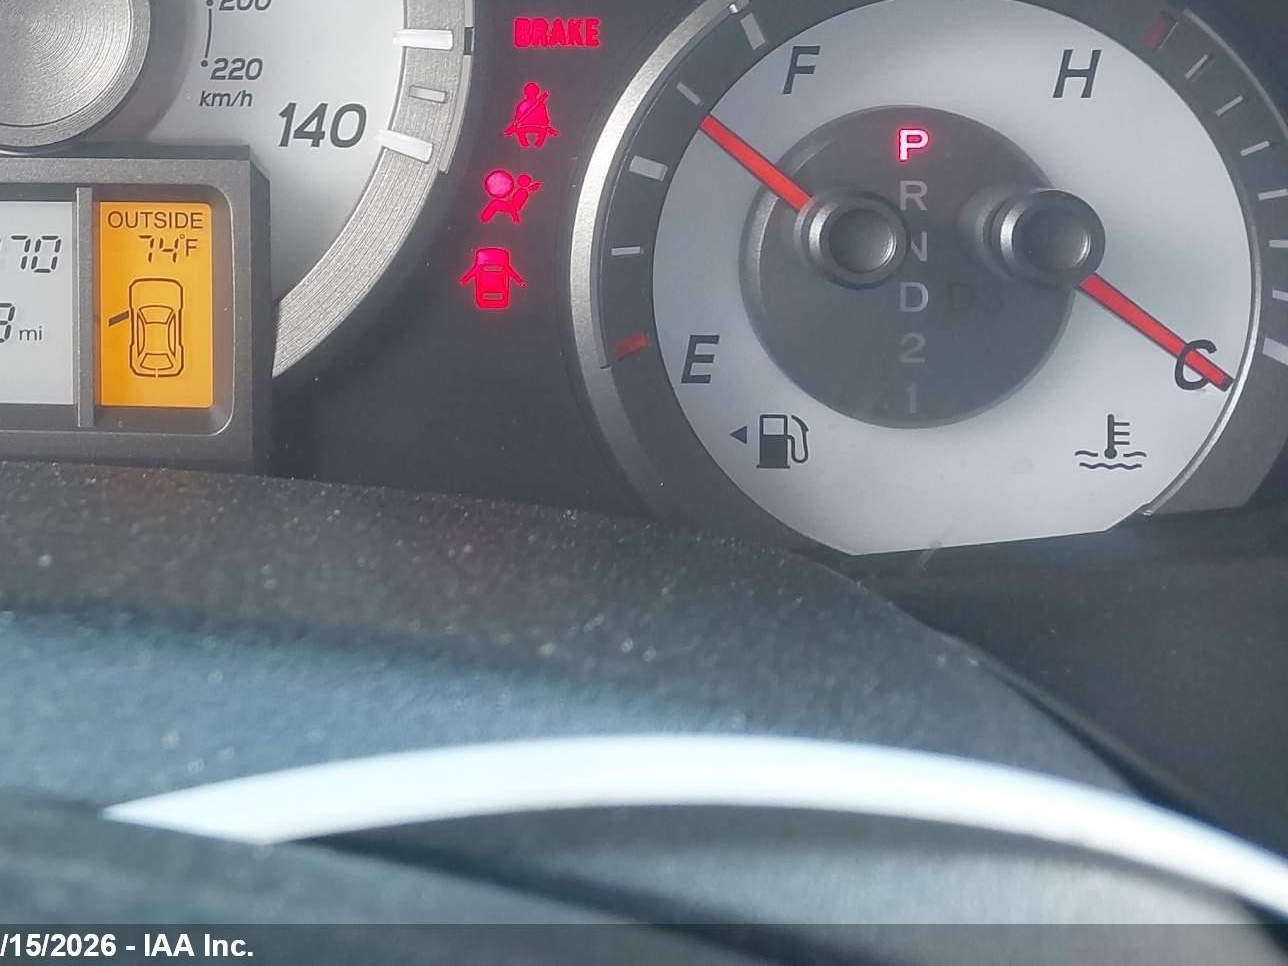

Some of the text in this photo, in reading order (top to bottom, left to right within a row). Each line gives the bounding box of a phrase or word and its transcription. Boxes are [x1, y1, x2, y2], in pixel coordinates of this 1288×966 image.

[513, 17, 601, 48] BRAKE
[211, 58, 263, 81] 220
[782, 45, 821, 96] F
[1052, 48, 1102, 99] H
[199, 90, 253, 108] km/h
[278, 102, 368, 148] 140
[898, 129, 929, 160] P
[899, 180, 929, 211] R
[107, 210, 204, 230] OUTSIDE
[899, 283, 929, 312] D
[19, 326, 42, 341] mi
[899, 333, 927, 363] 2
[681, 334, 720, 384] E
[1174, 340, 1217, 391] C
